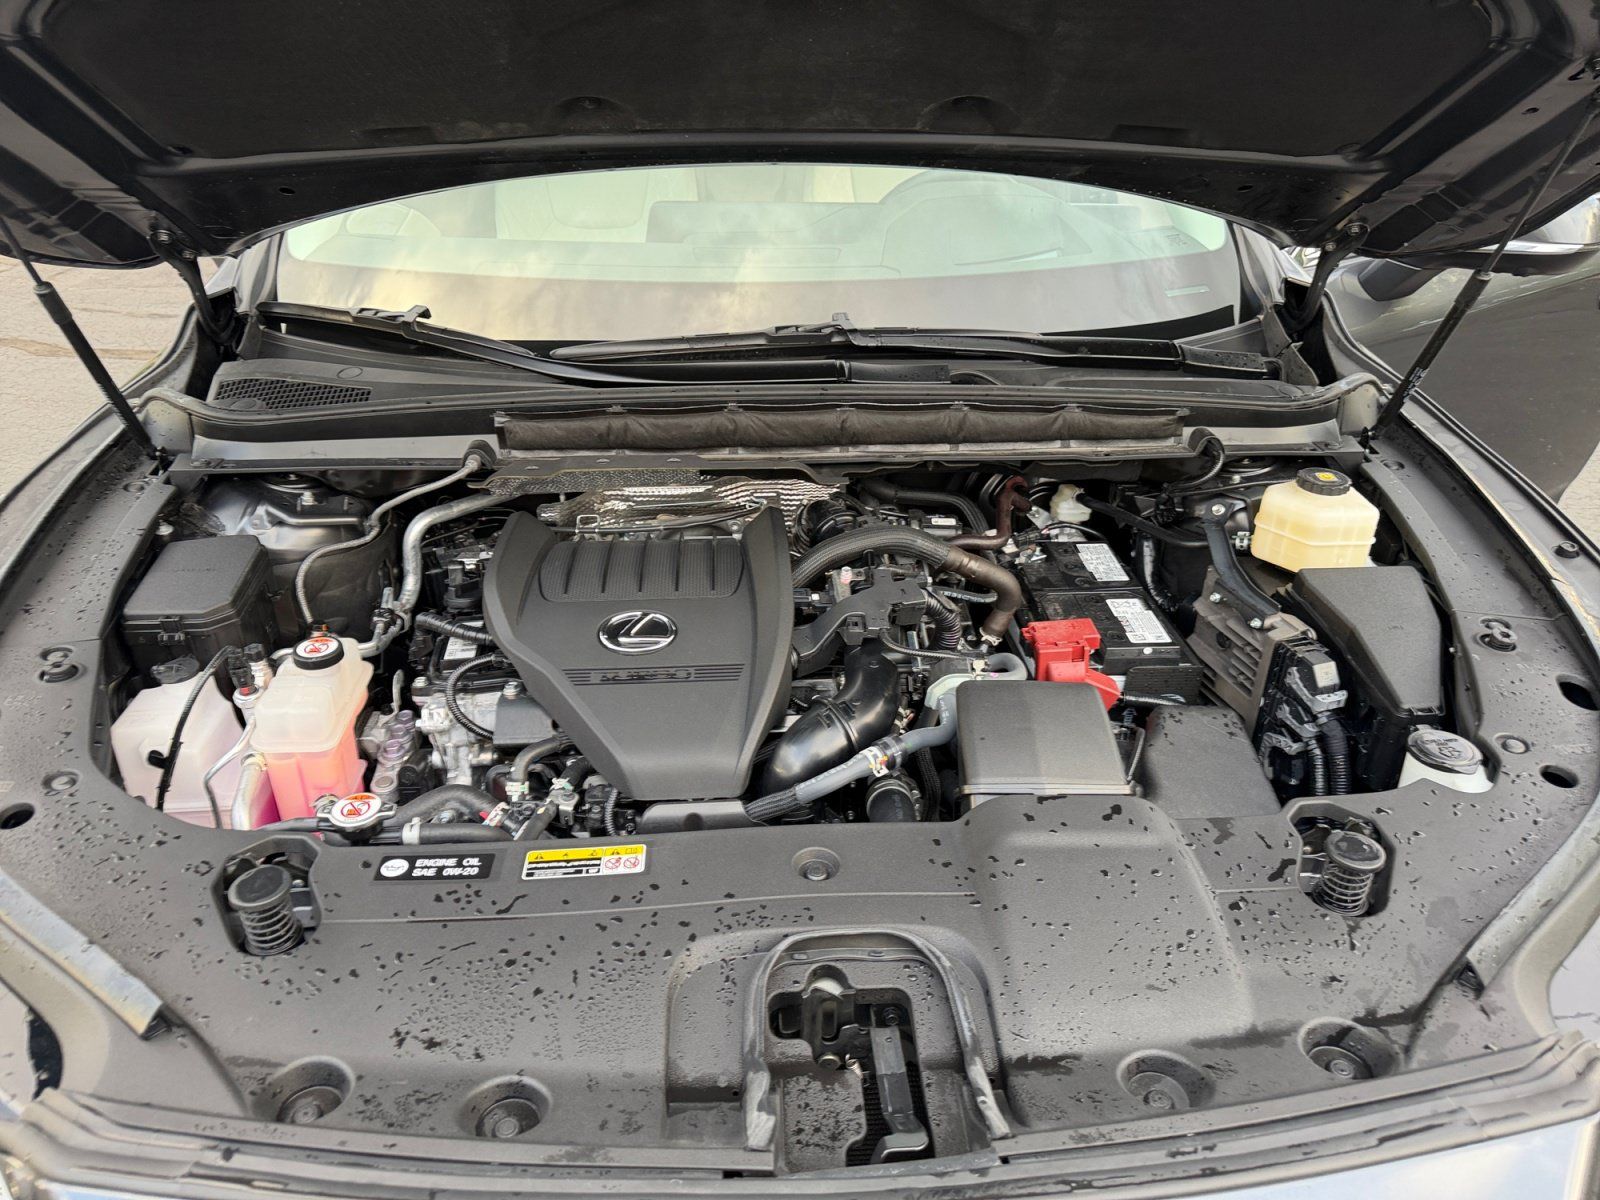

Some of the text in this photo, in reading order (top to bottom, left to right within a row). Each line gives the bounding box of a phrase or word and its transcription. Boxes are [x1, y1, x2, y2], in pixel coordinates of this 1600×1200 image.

[415, 857, 482, 867] ENGINE OIL
[411, 868, 438, 877] SAE
[442, 867, 480, 876] 0W-20
